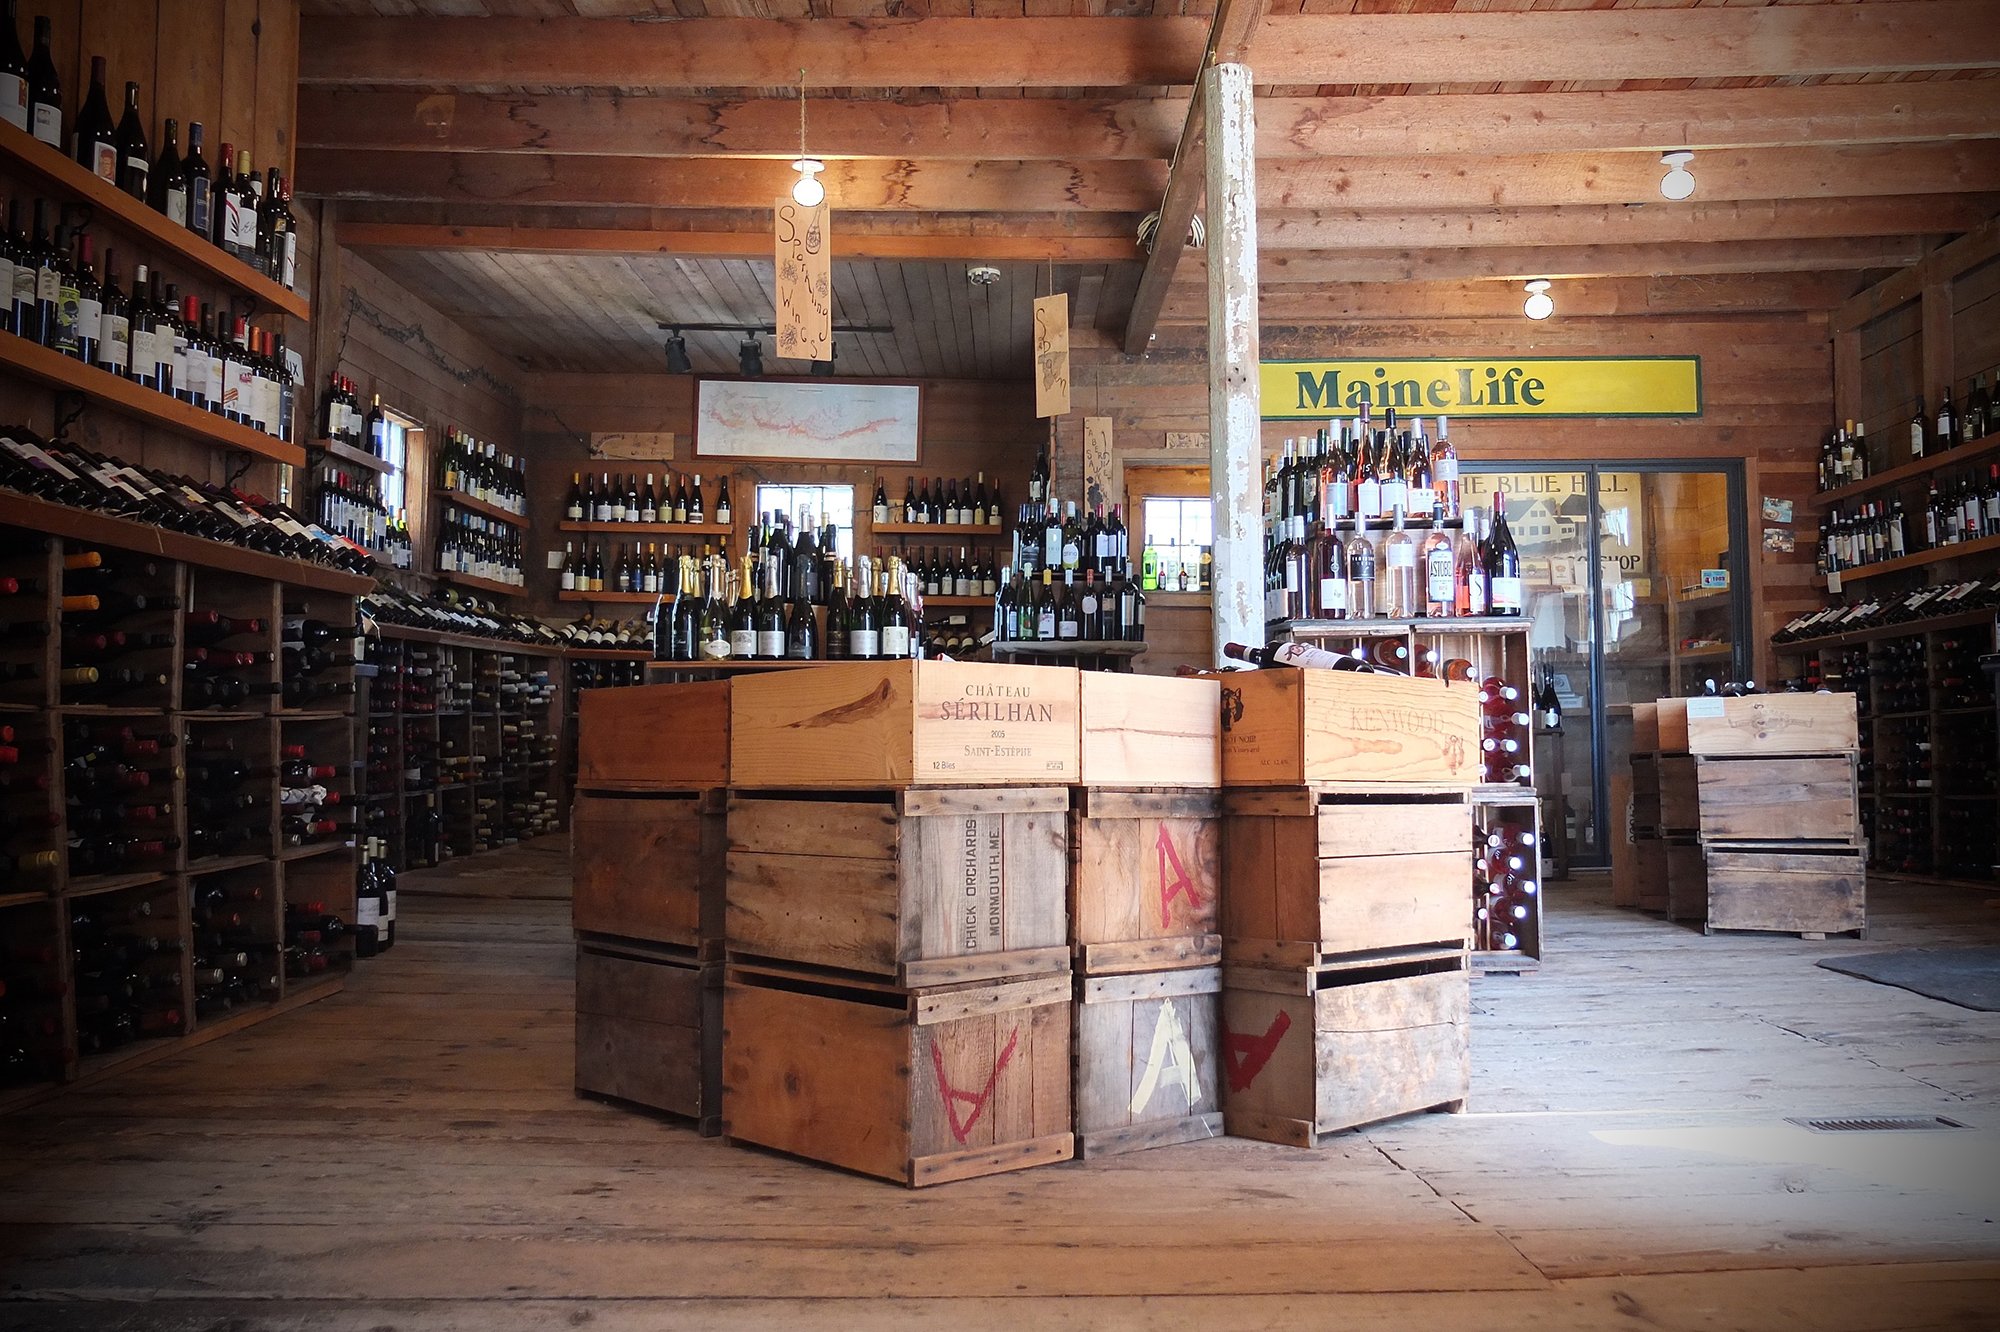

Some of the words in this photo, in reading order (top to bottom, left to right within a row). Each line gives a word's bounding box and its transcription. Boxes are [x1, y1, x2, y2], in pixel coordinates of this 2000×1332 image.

[1497, 475, 1561, 494] BLUE
[1572, 475, 1628, 492] HLL
[965, 683, 1031, 698] CHÂTEAU
[940, 698, 1053, 722] SÉRILHAN
[1349, 706, 1445, 734] KENWOOD
[933, 761, 940, 770] 12
[965, 819, 977, 896] ORCHARDS
[1157, 821, 1200, 929] A
[965, 905, 977, 949] CHICK
[1128, 998, 1202, 1115] A
[931, 1025, 1018, 1144] A
